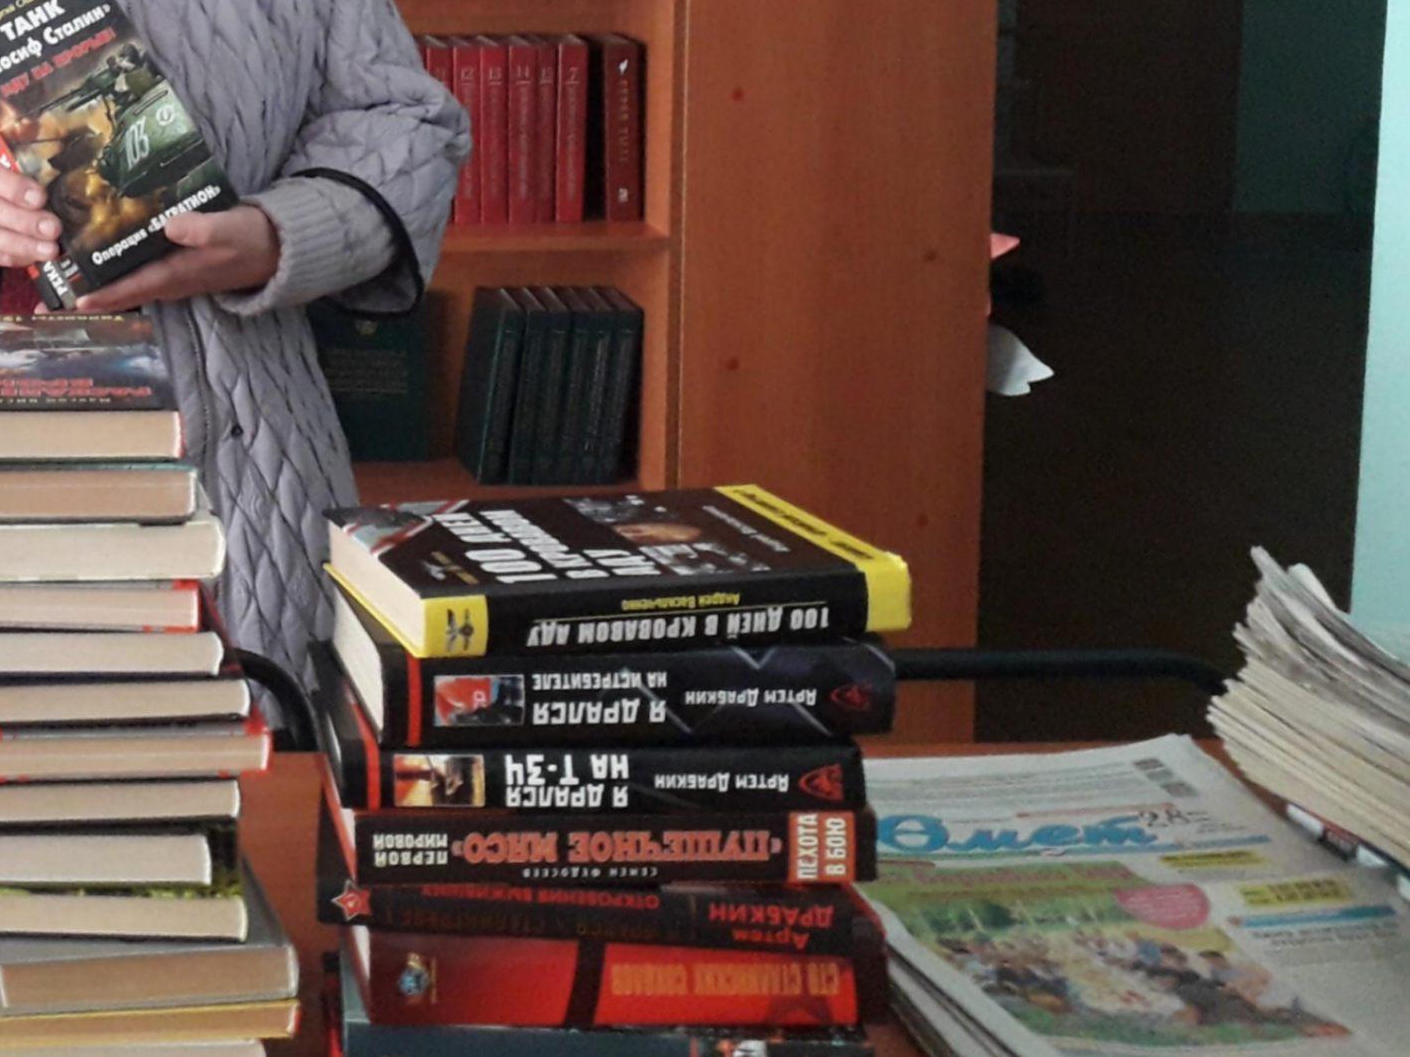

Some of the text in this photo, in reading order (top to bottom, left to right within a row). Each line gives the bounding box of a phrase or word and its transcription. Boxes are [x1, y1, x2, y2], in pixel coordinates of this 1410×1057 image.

[42, 3, 111, 45] Сталин»
[91, 227, 149, 265] Операция
[465, 548, 558, 584] 100
[526, 606, 829, 647] 100 ДНЕЙ В КРОВАВОМ АДУ
[532, 672, 668, 689] НА ИСТРЕБИТЕЛЕ
[532, 699, 667, 725] Я ДРАЛСЯ
[590, 754, 629, 778] НА
[505, 783, 629, 807] Я ДРАЛСЯ
[372, 832, 449, 848] МИРОВОЙ
[450, 828, 782, 865] «ПУШЕЧНОЕ МЯСО»
[797, 812, 819, 880] ПЕХОТА
[825, 817, 847, 876] В БОЮ
[372, 849, 449, 867] ПЕРВОЙ
[708, 901, 834, 926] ДРАБКИН
[807, 962, 840, 995] СТО
